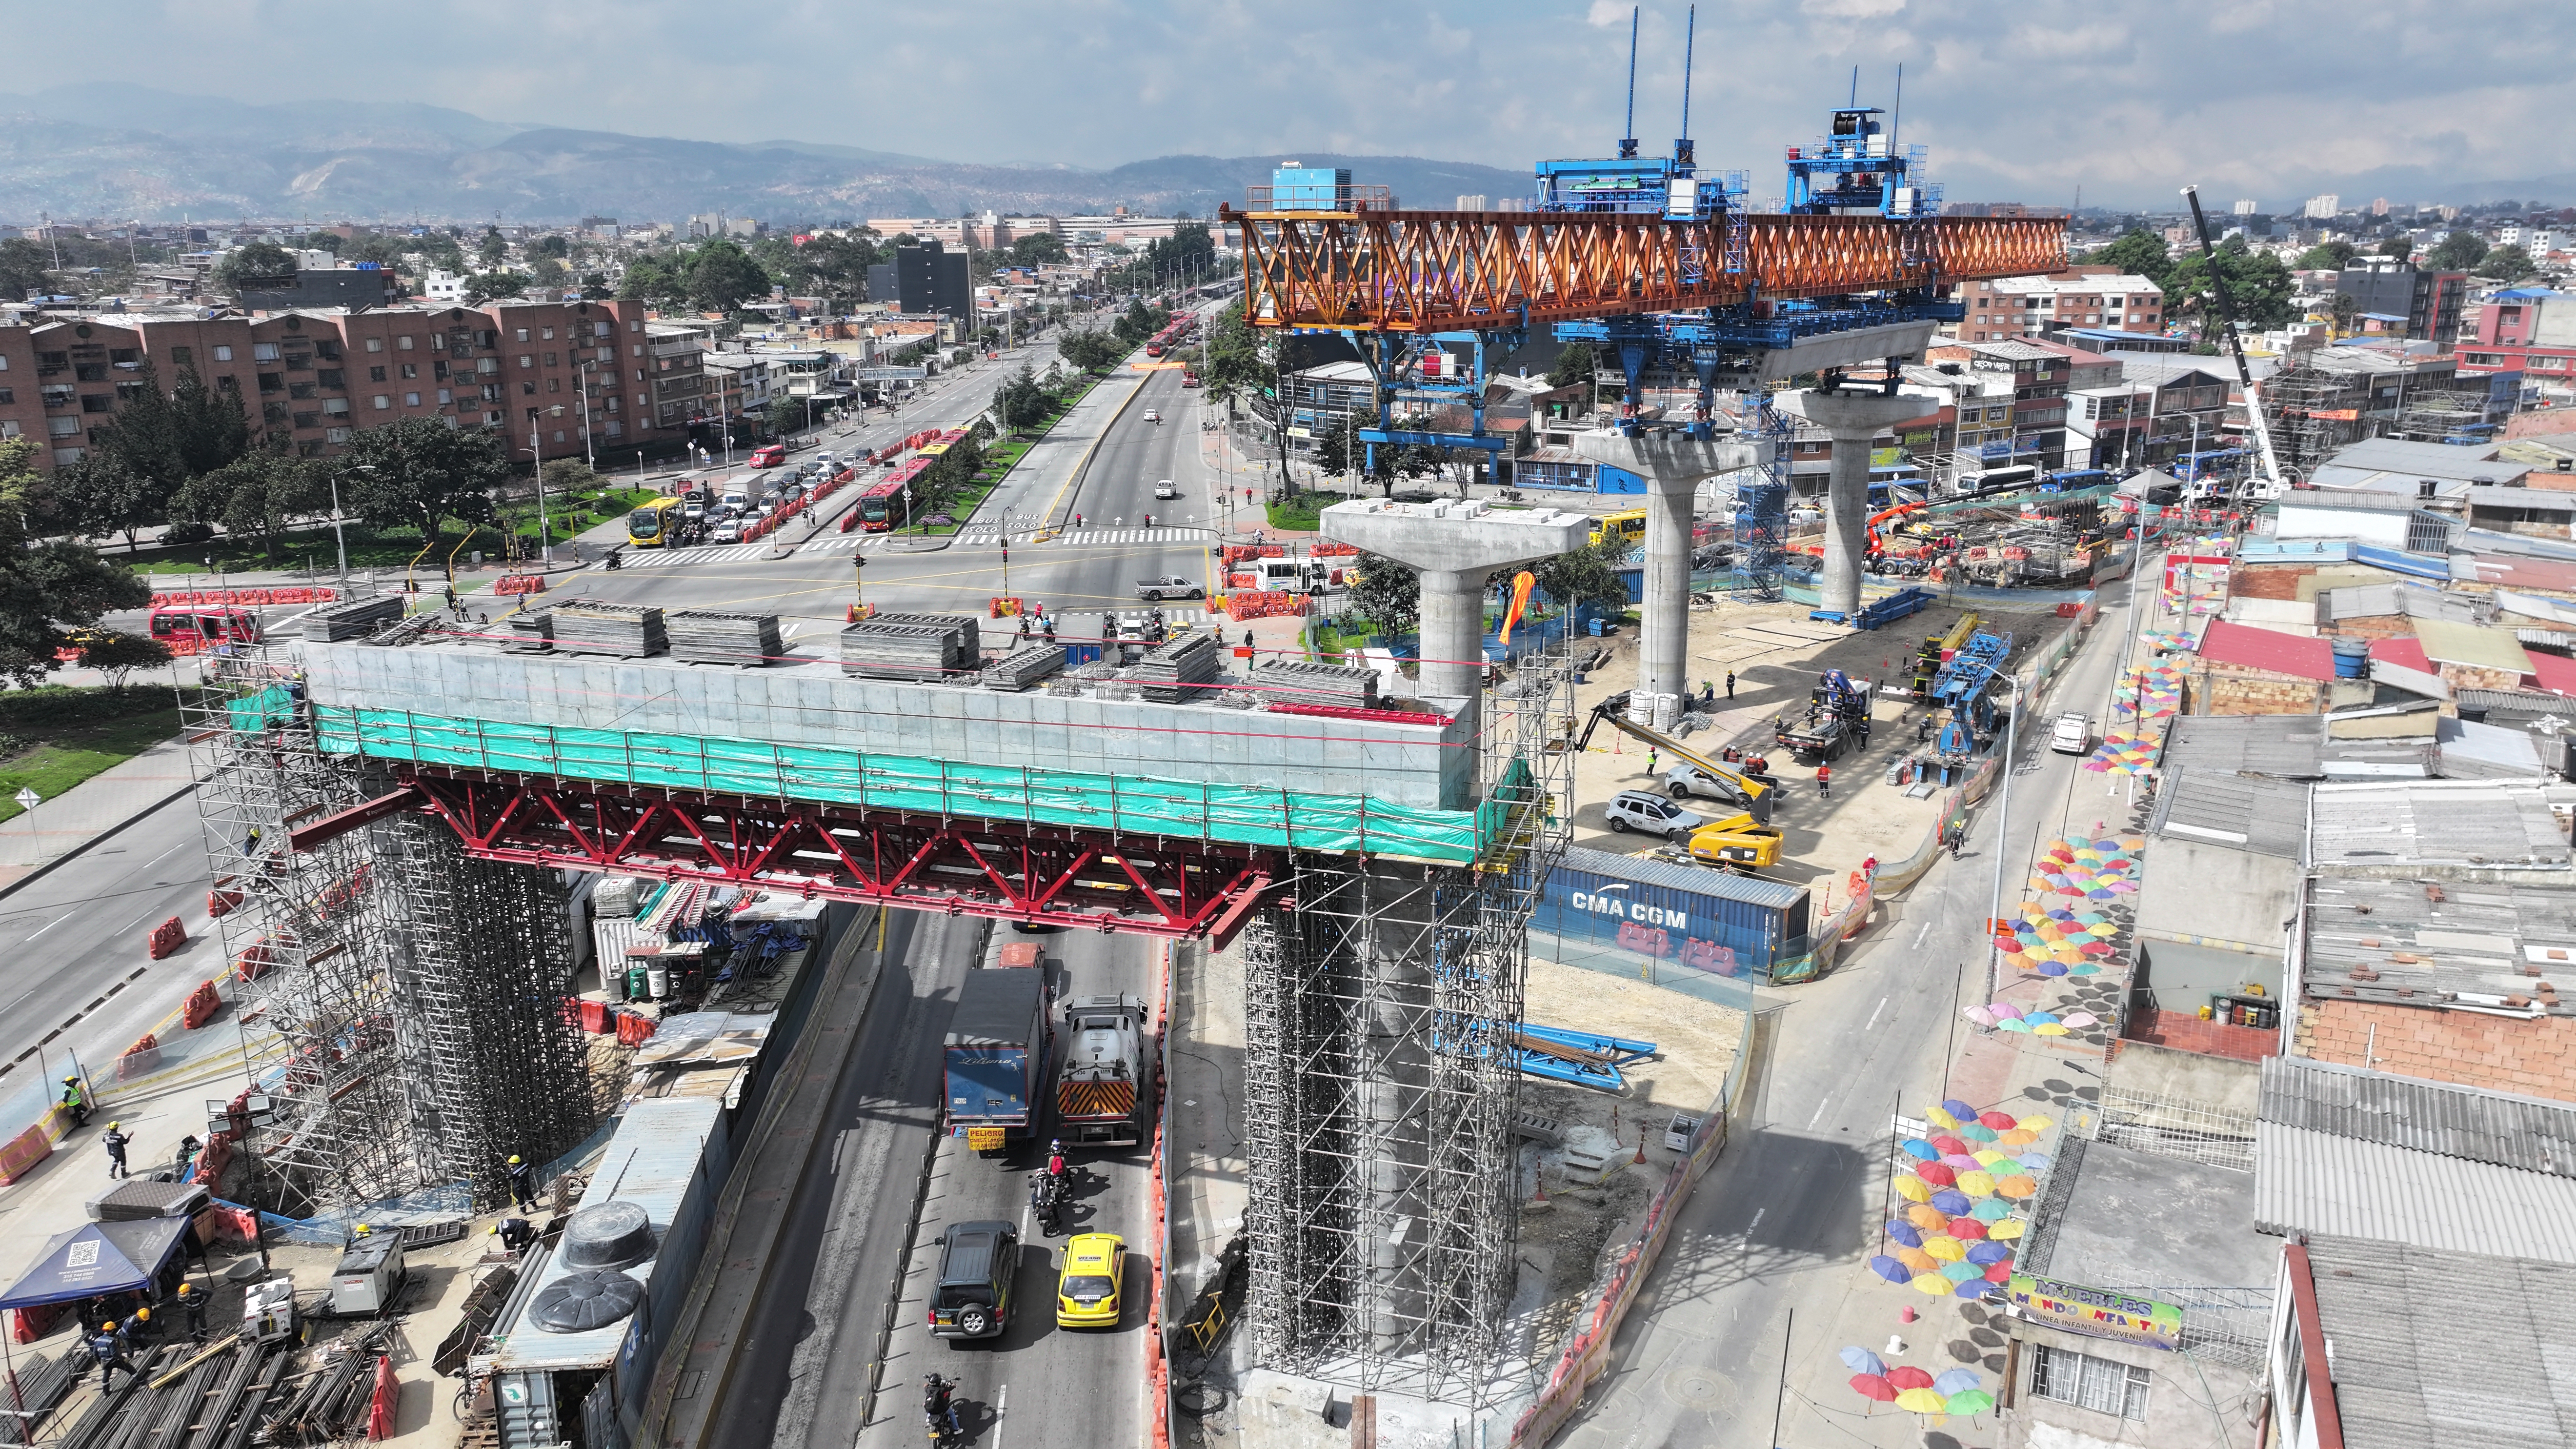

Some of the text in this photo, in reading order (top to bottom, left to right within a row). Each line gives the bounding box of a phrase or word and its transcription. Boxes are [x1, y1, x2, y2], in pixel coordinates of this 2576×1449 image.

[1572, 892, 1687, 929] CMA CGM
[958, 1057, 1012, 1065] Liliana
[2015, 1292, 2168, 1336] MUNDO INFANTIL
[2034, 1279, 2152, 1317] MUEBLES
[2035, 1313, 2059, 1325] LINEA
[2061, 1319, 2099, 1333] INFANTIL
[2108, 1328, 2143, 1342] JUVENIL
